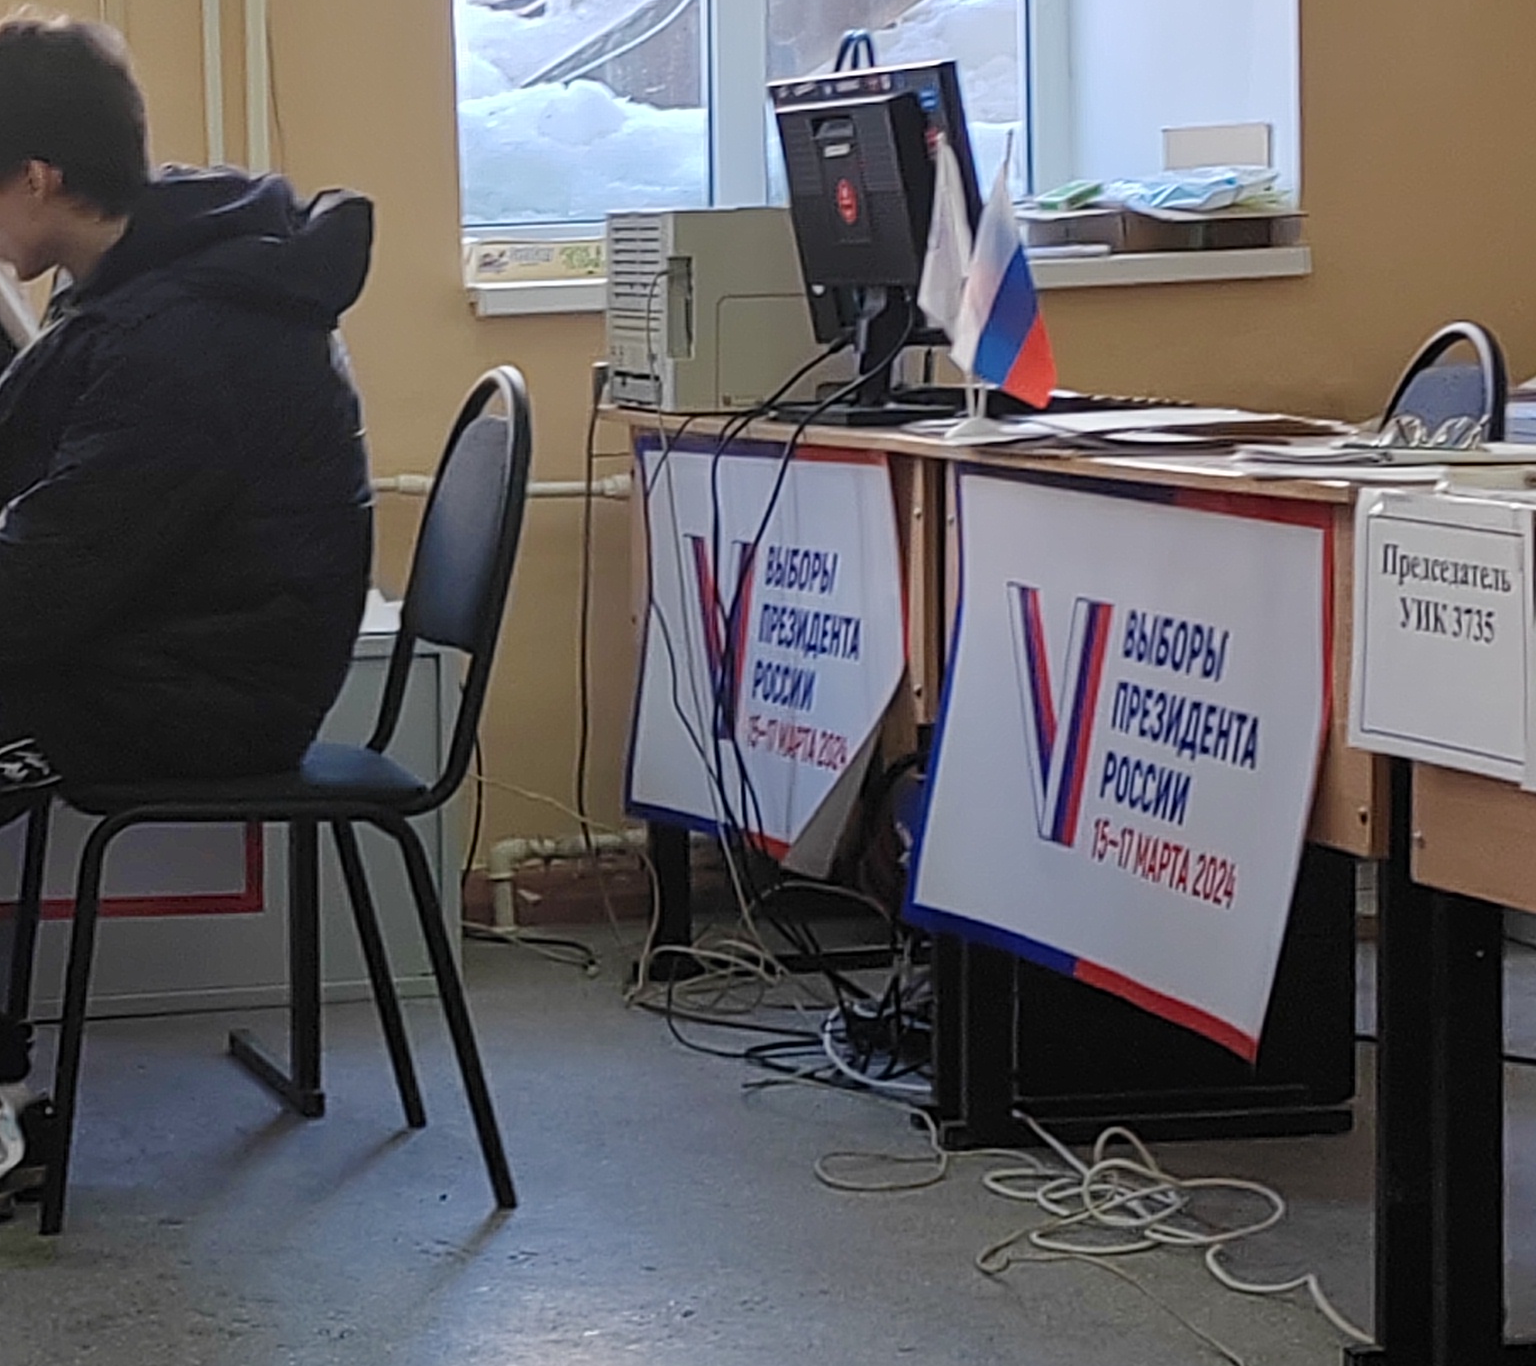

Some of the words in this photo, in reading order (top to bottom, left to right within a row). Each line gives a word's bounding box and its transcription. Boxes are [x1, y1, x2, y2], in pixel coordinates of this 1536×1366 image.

[765, 545, 838, 593] ВЫБОРЫ
[1382, 542, 1512, 593] Председатель
[758, 603, 861, 660] ПРЕЗИДЕНТА
[1123, 609, 1230, 681] ВЫБОРЫ
[1400, 596, 1447, 635] УИК
[1452, 606, 1495, 644] 3735
[752, 660, 816, 712] РОССИИ
[778, 722, 816, 762] МАРТА
[817, 731, 848, 770] 2024
[1111, 681, 1260, 770] ПРЕЗИДЕНТА
[1099, 750, 1192, 826] РОССИИ
[1132, 832, 1191, 893] МАРТА
[1192, 853, 1237, 910] 2024
